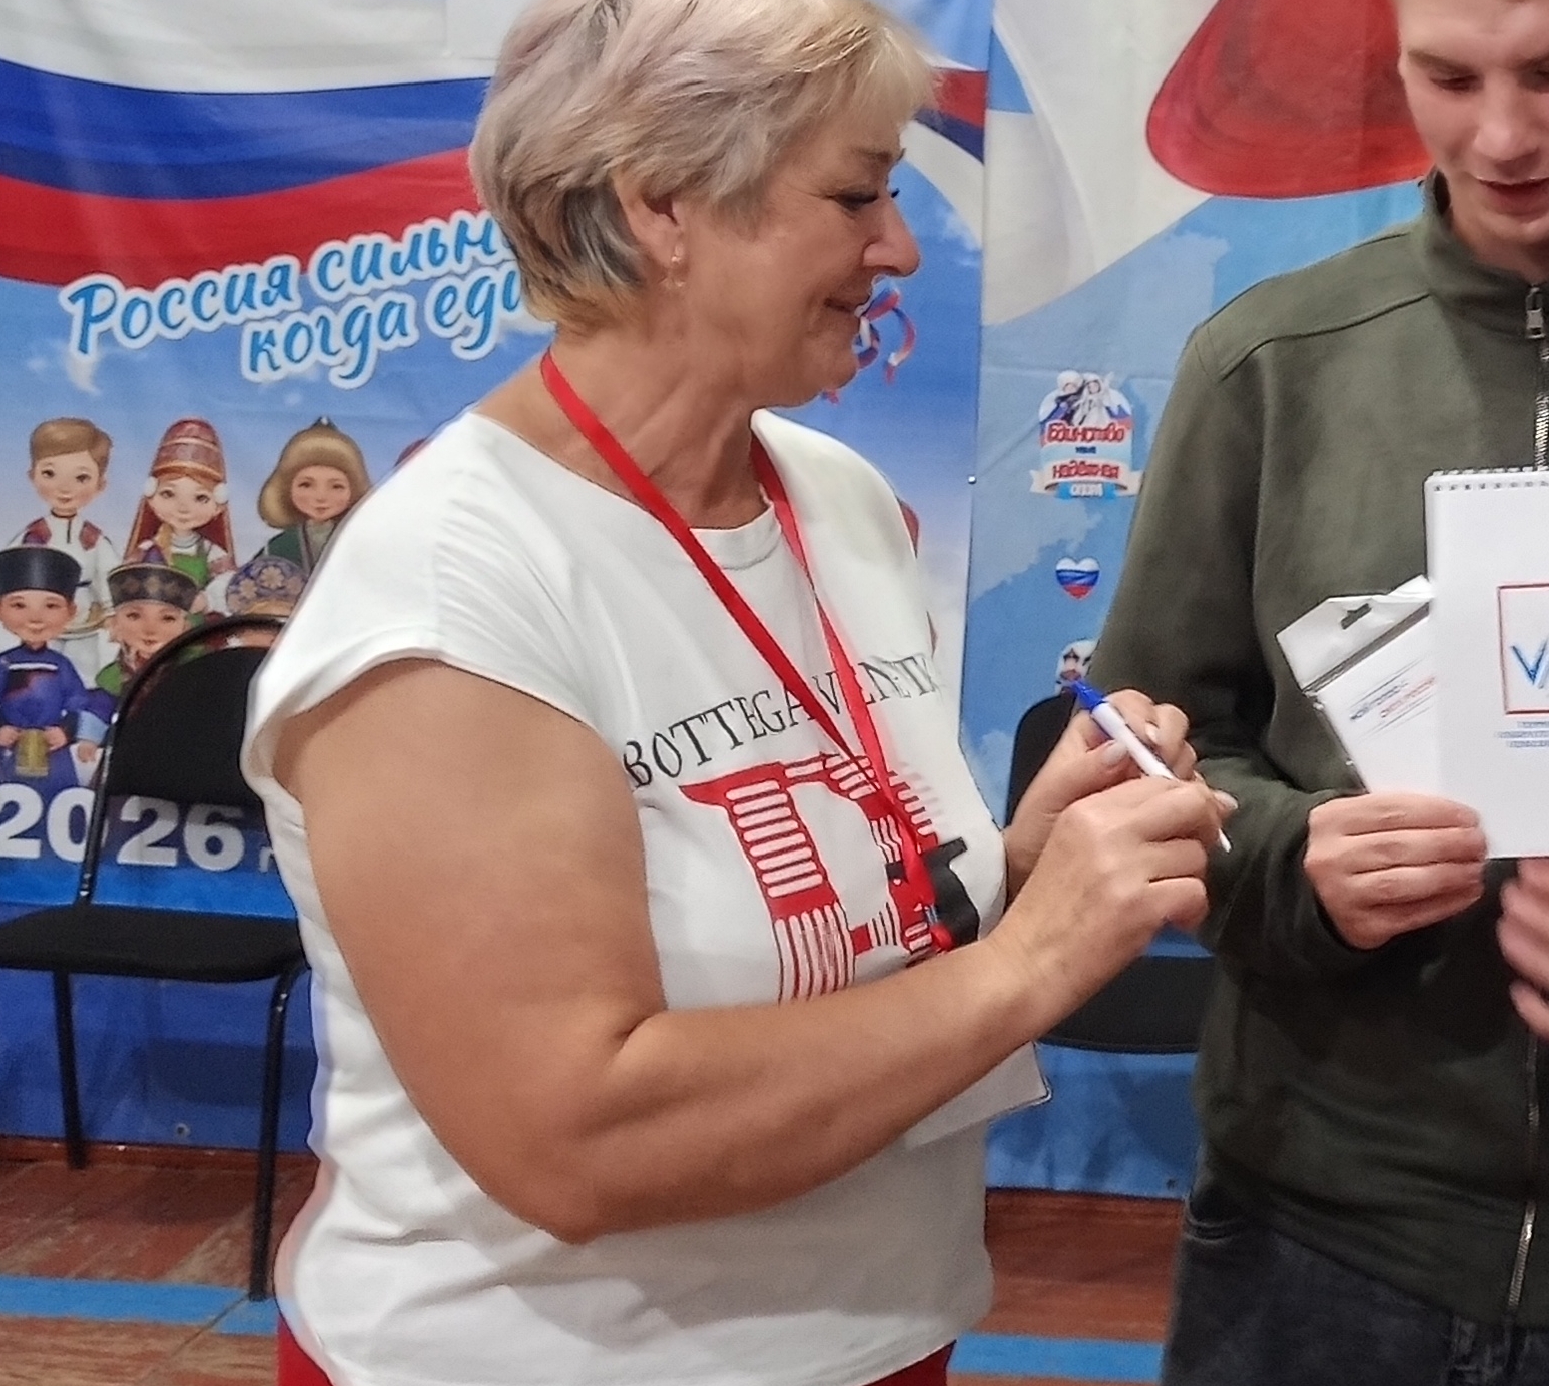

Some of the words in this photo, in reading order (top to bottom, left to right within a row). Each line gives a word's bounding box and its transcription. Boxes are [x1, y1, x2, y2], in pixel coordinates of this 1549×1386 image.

[67, 263, 294, 354] Россия
[316, 217, 513, 293] сильн
[249, 299, 409, 380] когда
[623, 683, 815, 789] BOTTEGA
